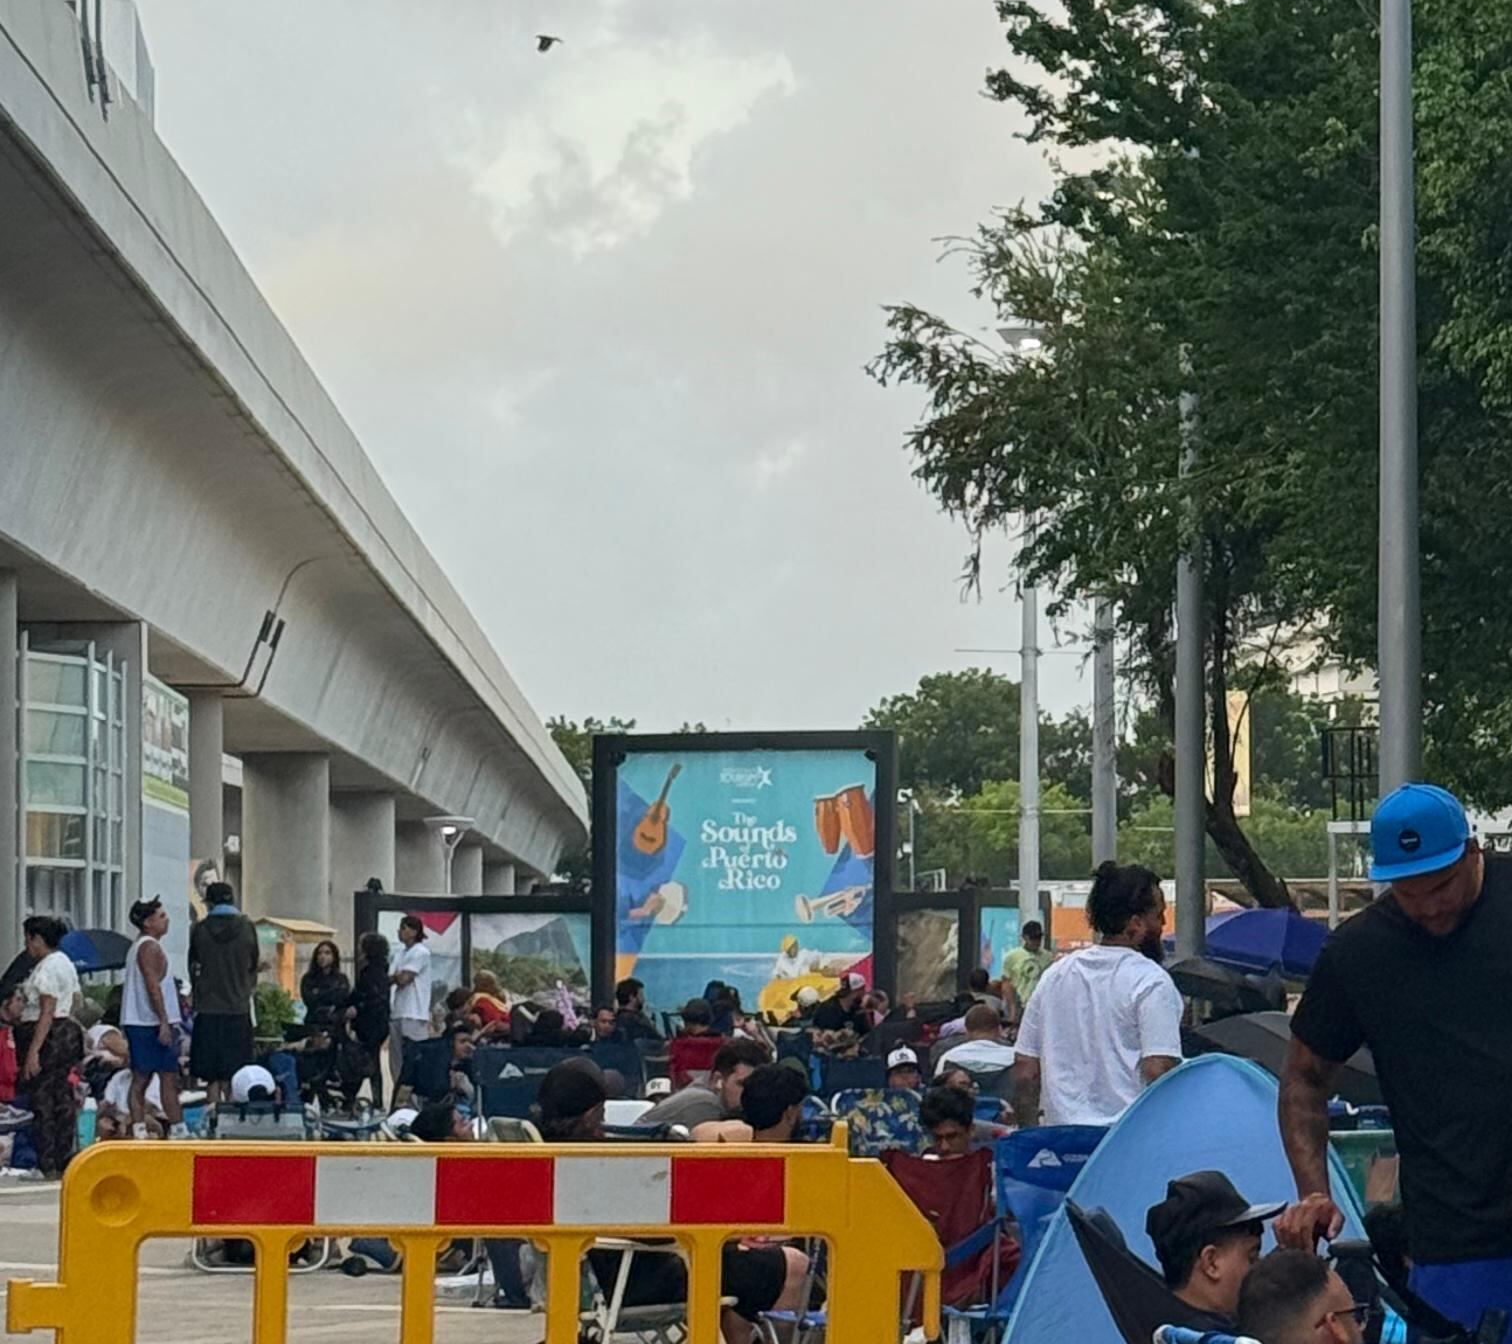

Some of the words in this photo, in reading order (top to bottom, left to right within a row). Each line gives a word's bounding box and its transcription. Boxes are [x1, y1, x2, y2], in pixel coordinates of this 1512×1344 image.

[732, 811, 758, 827] The
[700, 818, 798, 849] Sounds
[701, 845, 789, 870] Puerto
[718, 868, 781, 890] Rico
